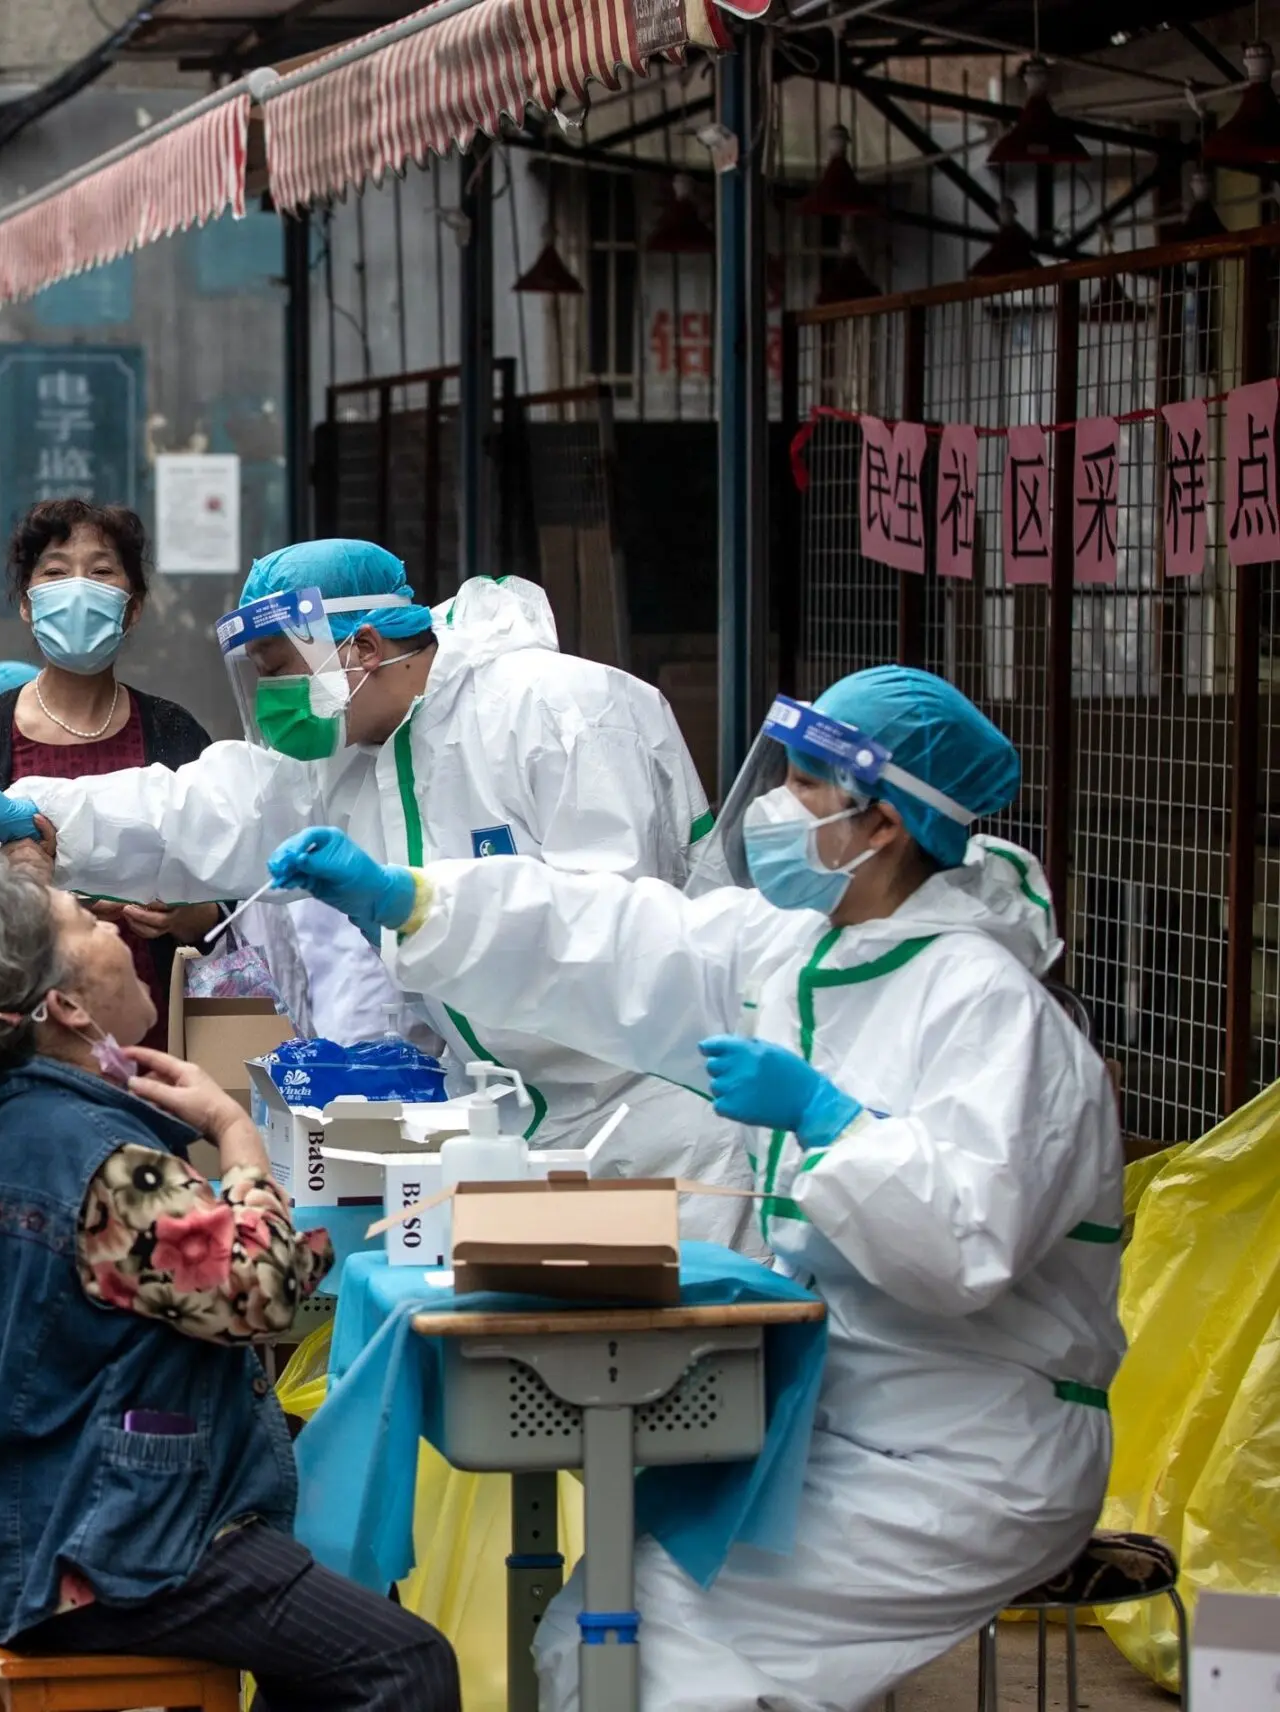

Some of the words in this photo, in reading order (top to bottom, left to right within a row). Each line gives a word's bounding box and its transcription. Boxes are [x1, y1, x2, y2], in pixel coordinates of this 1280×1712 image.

[866, 413, 1280, 562] 民生社区采样点
[279, 1086, 312, 1096] Vinda
